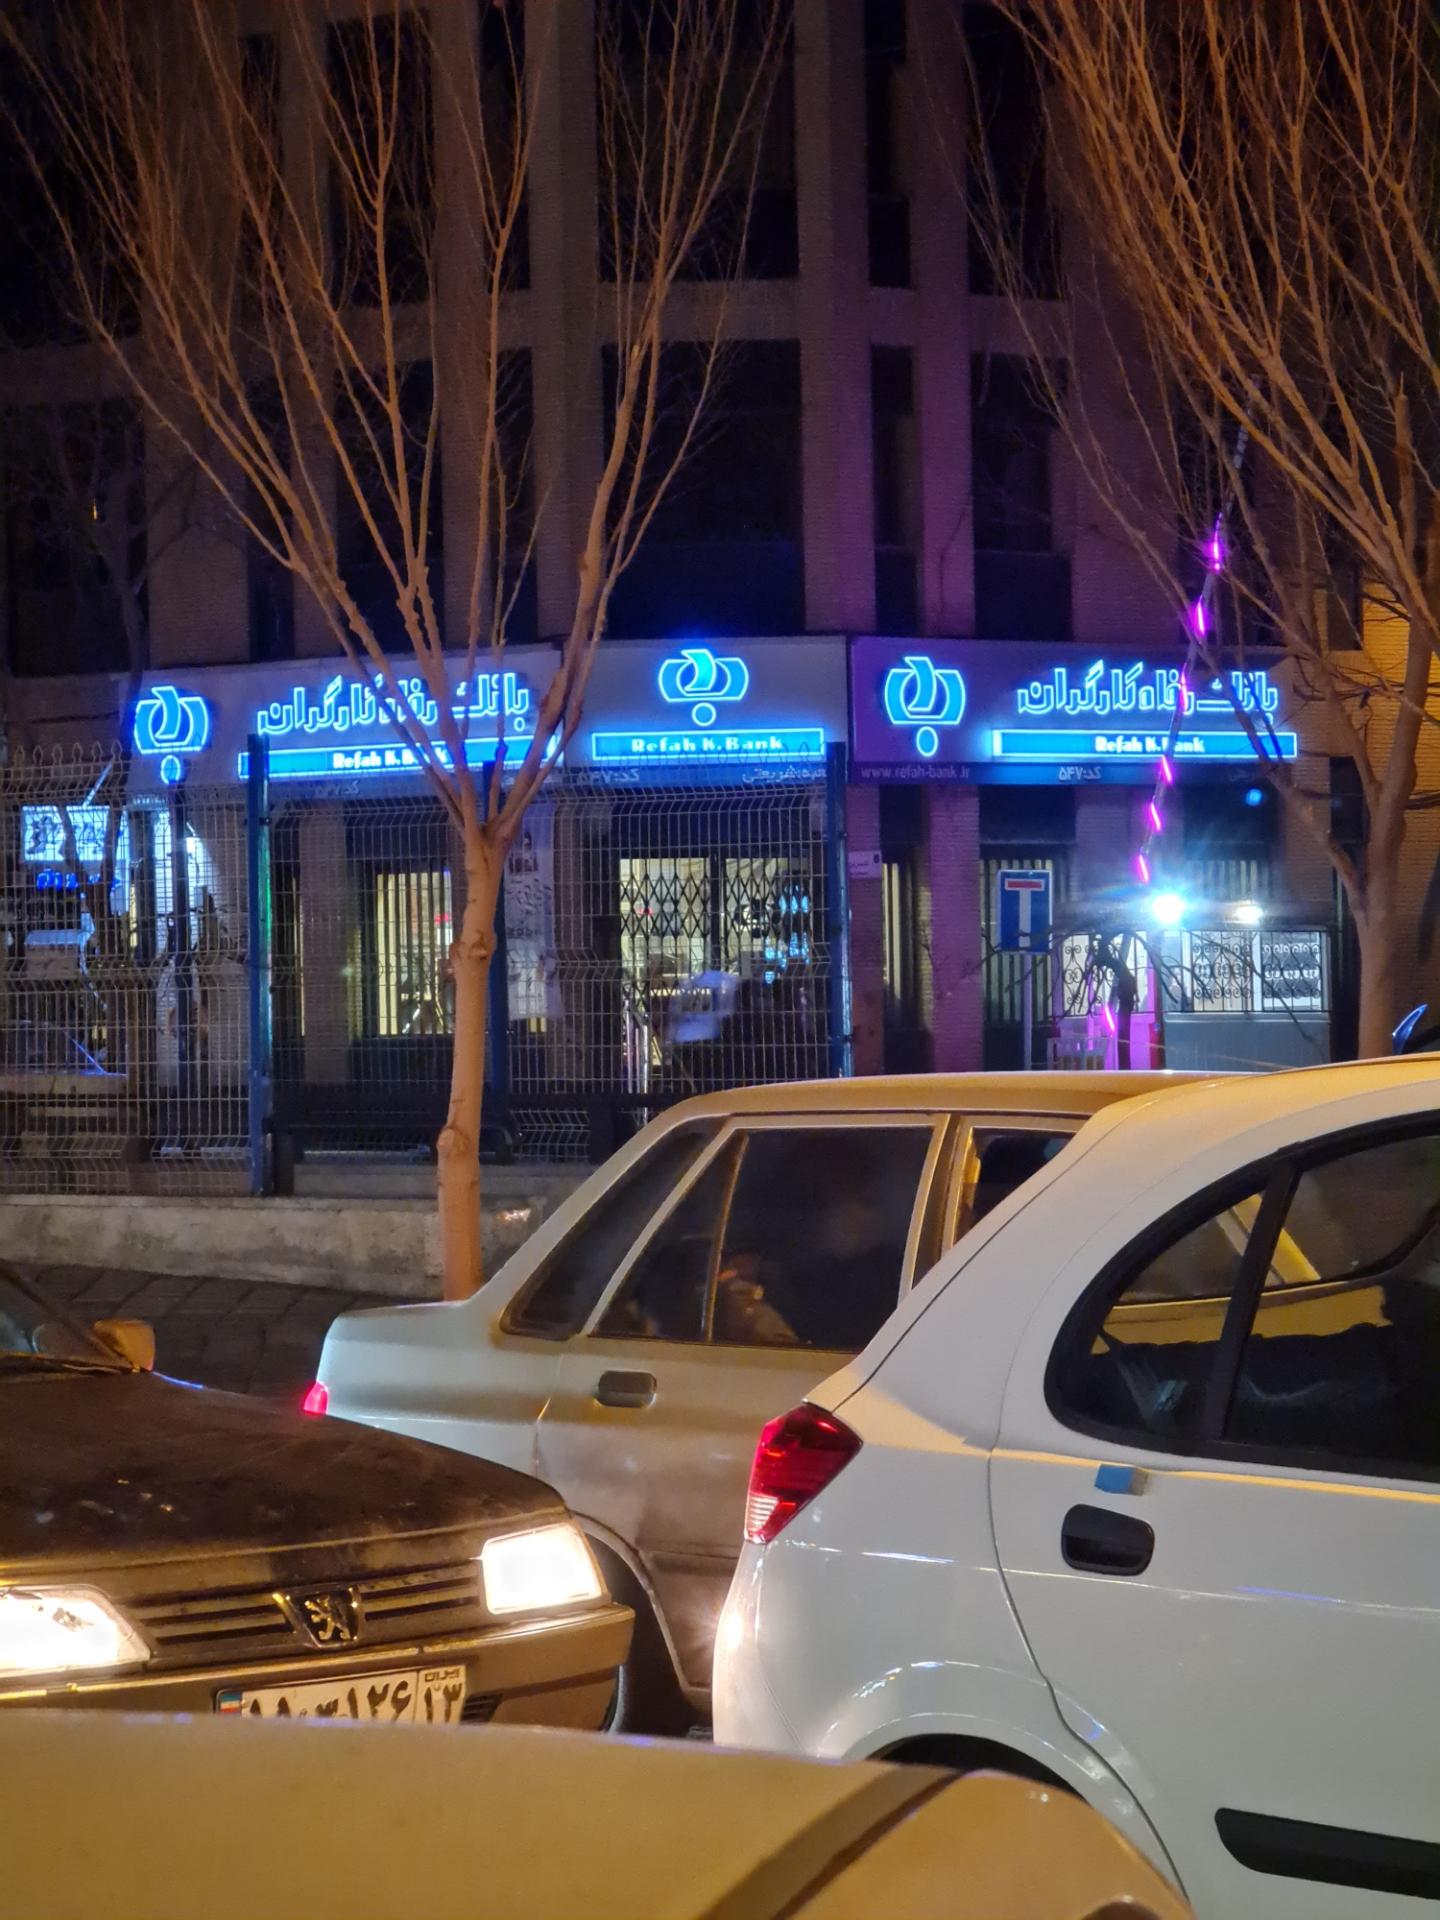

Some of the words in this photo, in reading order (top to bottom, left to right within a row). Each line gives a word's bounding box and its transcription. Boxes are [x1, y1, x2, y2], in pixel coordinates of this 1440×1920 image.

[1017, 659, 1143, 714] کارگران
[257, 673, 384, 736] کارگران
[632, 738, 696, 753] Refah
[1095, 735, 1142, 753] Refah
[333, 751, 381, 769] Refah
[385, 748, 447, 767] K.Bk
[860, 764, 970, 779] www.refah-bank.ir
[424, 1682, 462, 1723] ۱۳
